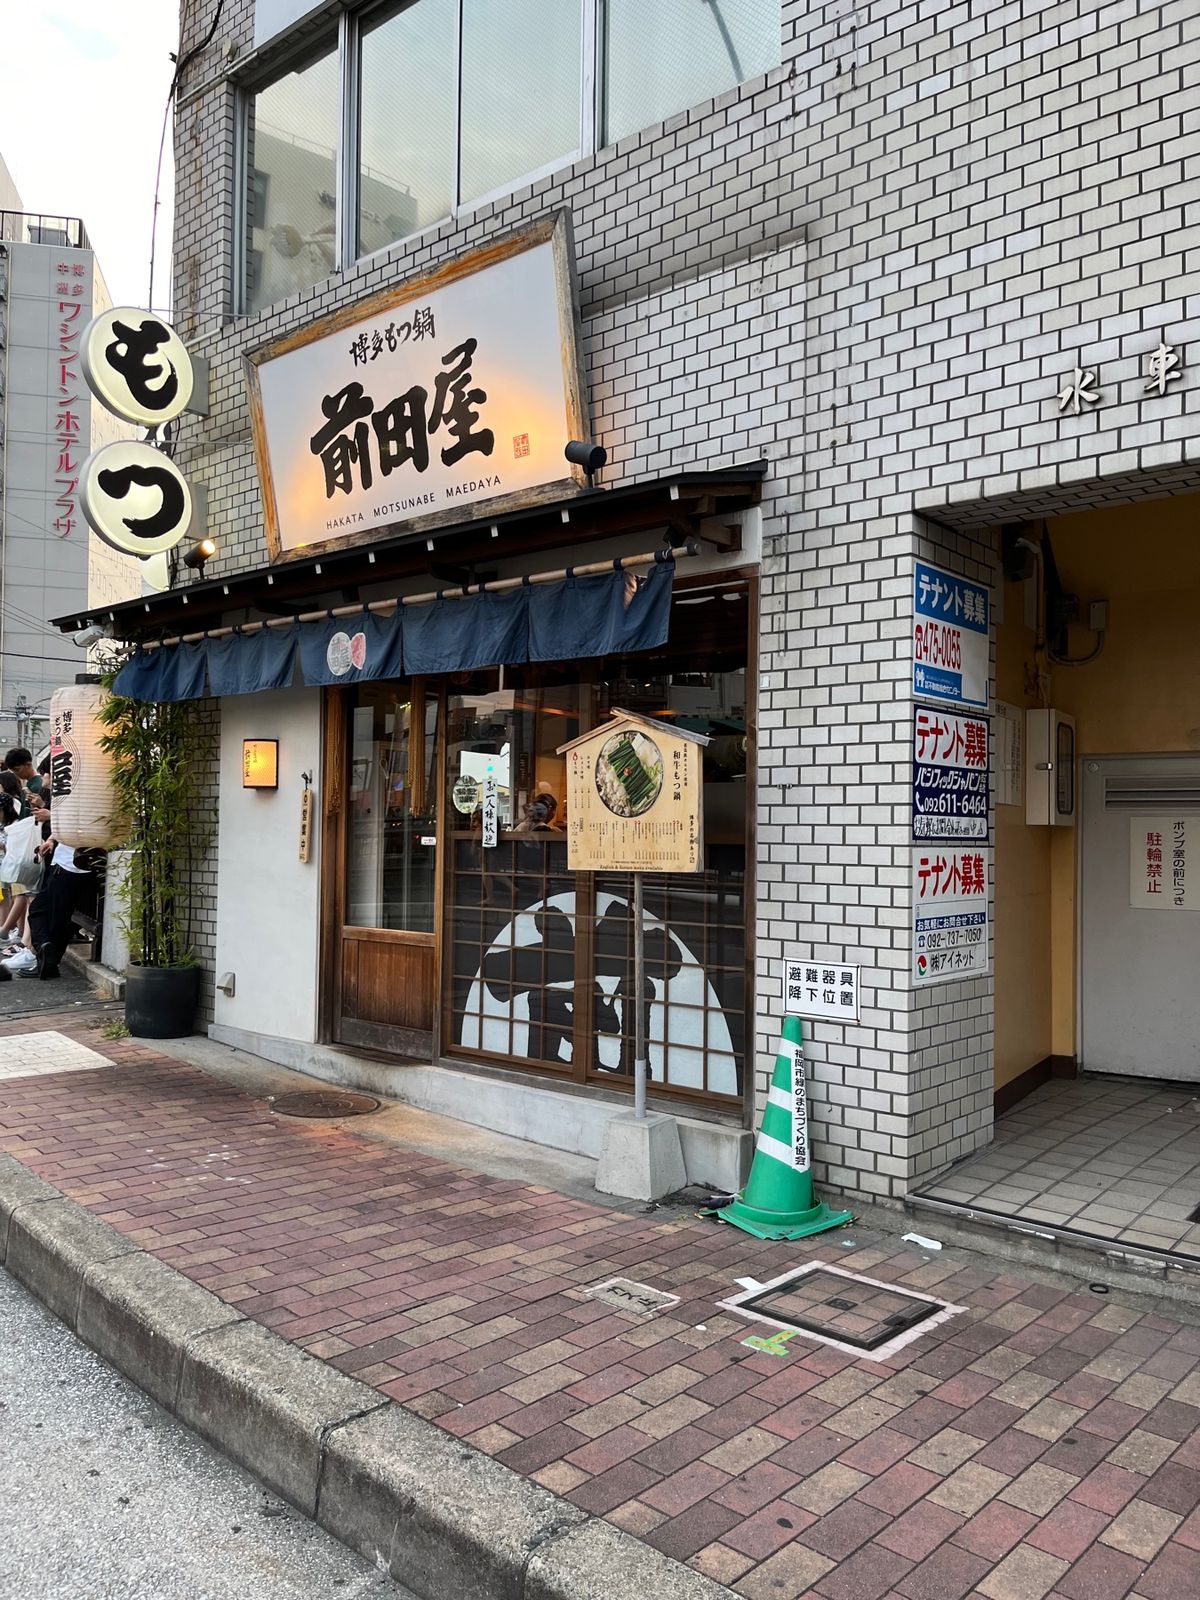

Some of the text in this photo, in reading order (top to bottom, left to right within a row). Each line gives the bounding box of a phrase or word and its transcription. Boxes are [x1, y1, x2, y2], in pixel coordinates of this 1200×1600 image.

[349, 306, 435, 367] 博多もつ鍋
[52, 301, 82, 538] ワシントンホテルプラザ
[310, 337, 495, 499] 前田屋
[326, 476, 501, 530] HAKATA MOTSUNABE MAEDAYA
[919, 574, 986, 625] テナント募集
[923, 621, 961, 670] 475-0055
[62, 710, 72, 734] 博多
[917, 715, 986, 768] テナント募集
[673, 750, 681, 801] 和牛もつ鍋
[484, 781, 496, 846] お一人様歓迎
[918, 853, 985, 898] テナント募集
[1146, 832, 1162, 894] 駐輪禁止
[1173, 821, 1185, 906] ポンプ室の前につき
[917, 914, 985, 931] お気軽にお問合せ下さい
[927, 928, 982, 948] 092-737-7050
[789, 966, 853, 987] 避難器具
[789, 985, 854, 1007] 降下位置
